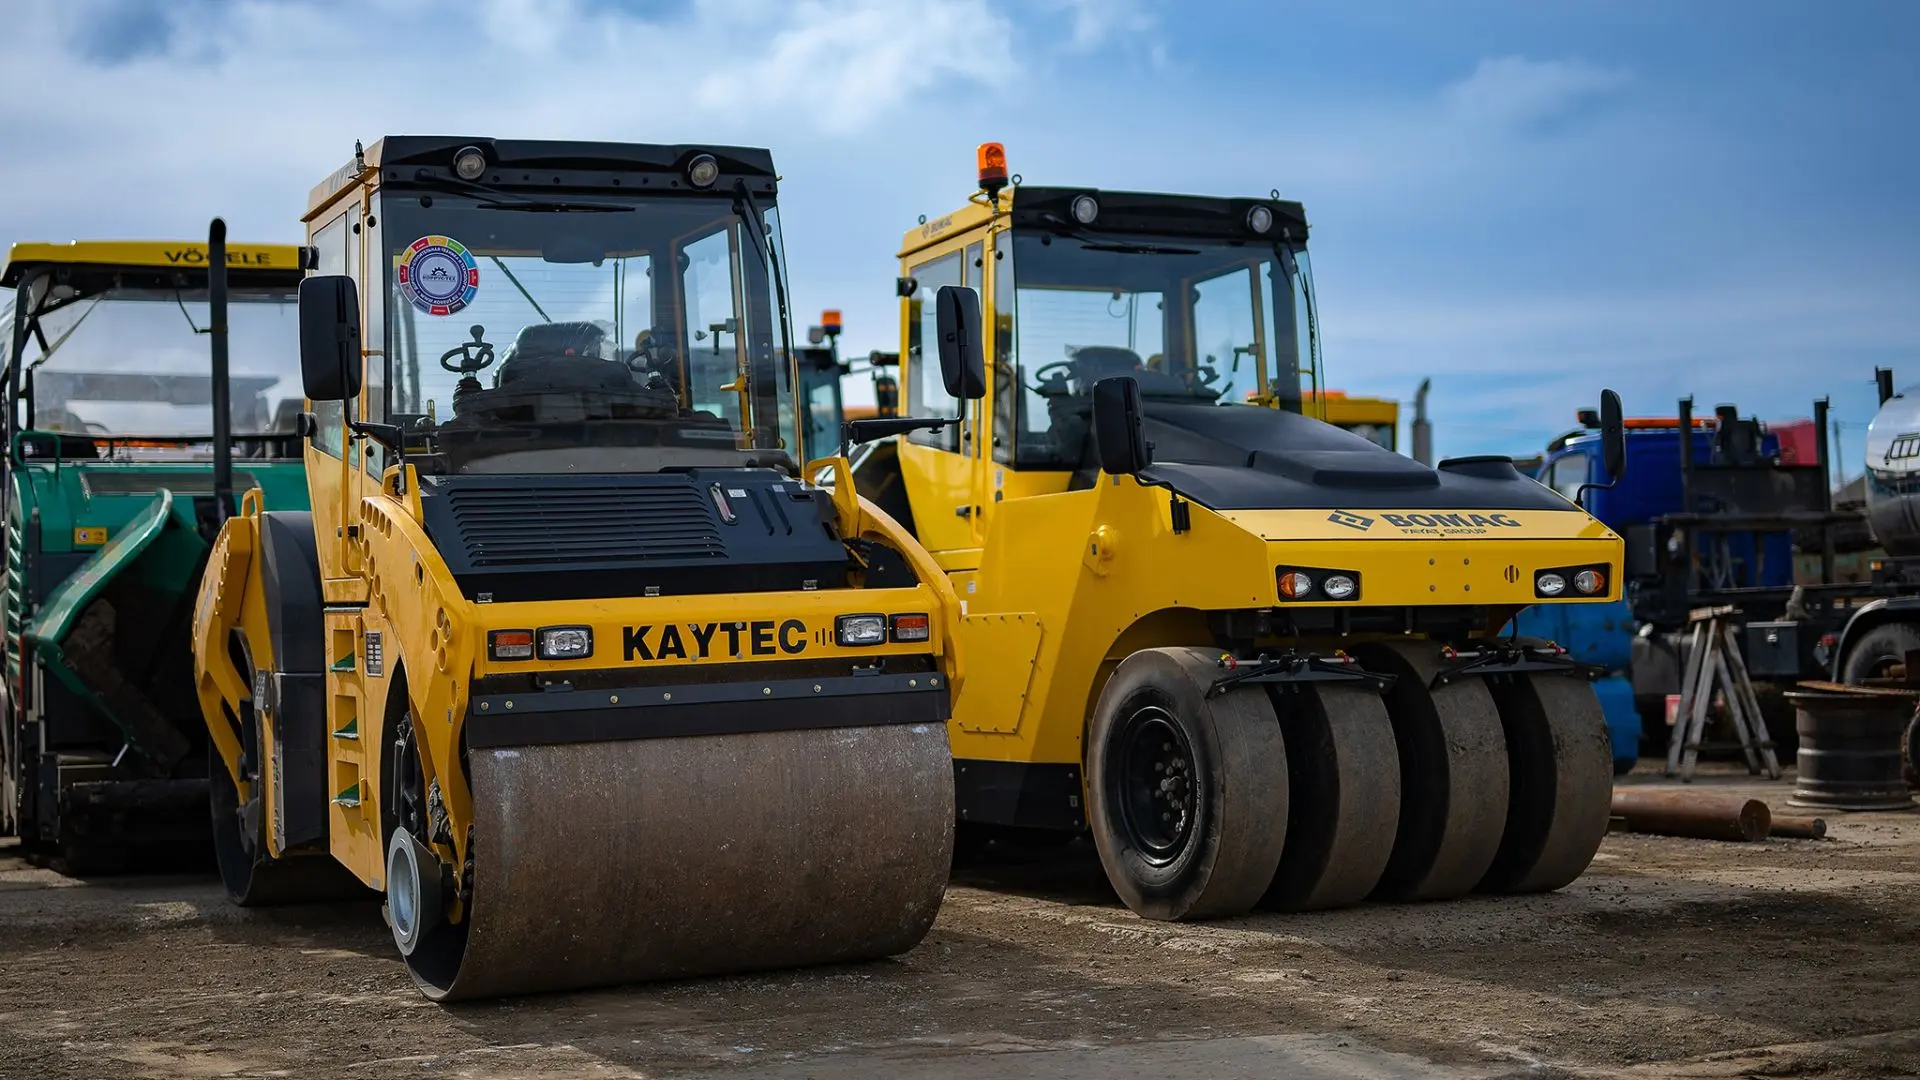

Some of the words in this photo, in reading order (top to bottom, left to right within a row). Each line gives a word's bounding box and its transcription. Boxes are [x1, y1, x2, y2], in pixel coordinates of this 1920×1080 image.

[164, 248, 272, 265] VÖELE
[1380, 514, 1522, 528] BOMAG
[622, 619, 808, 662] KAYTEC
